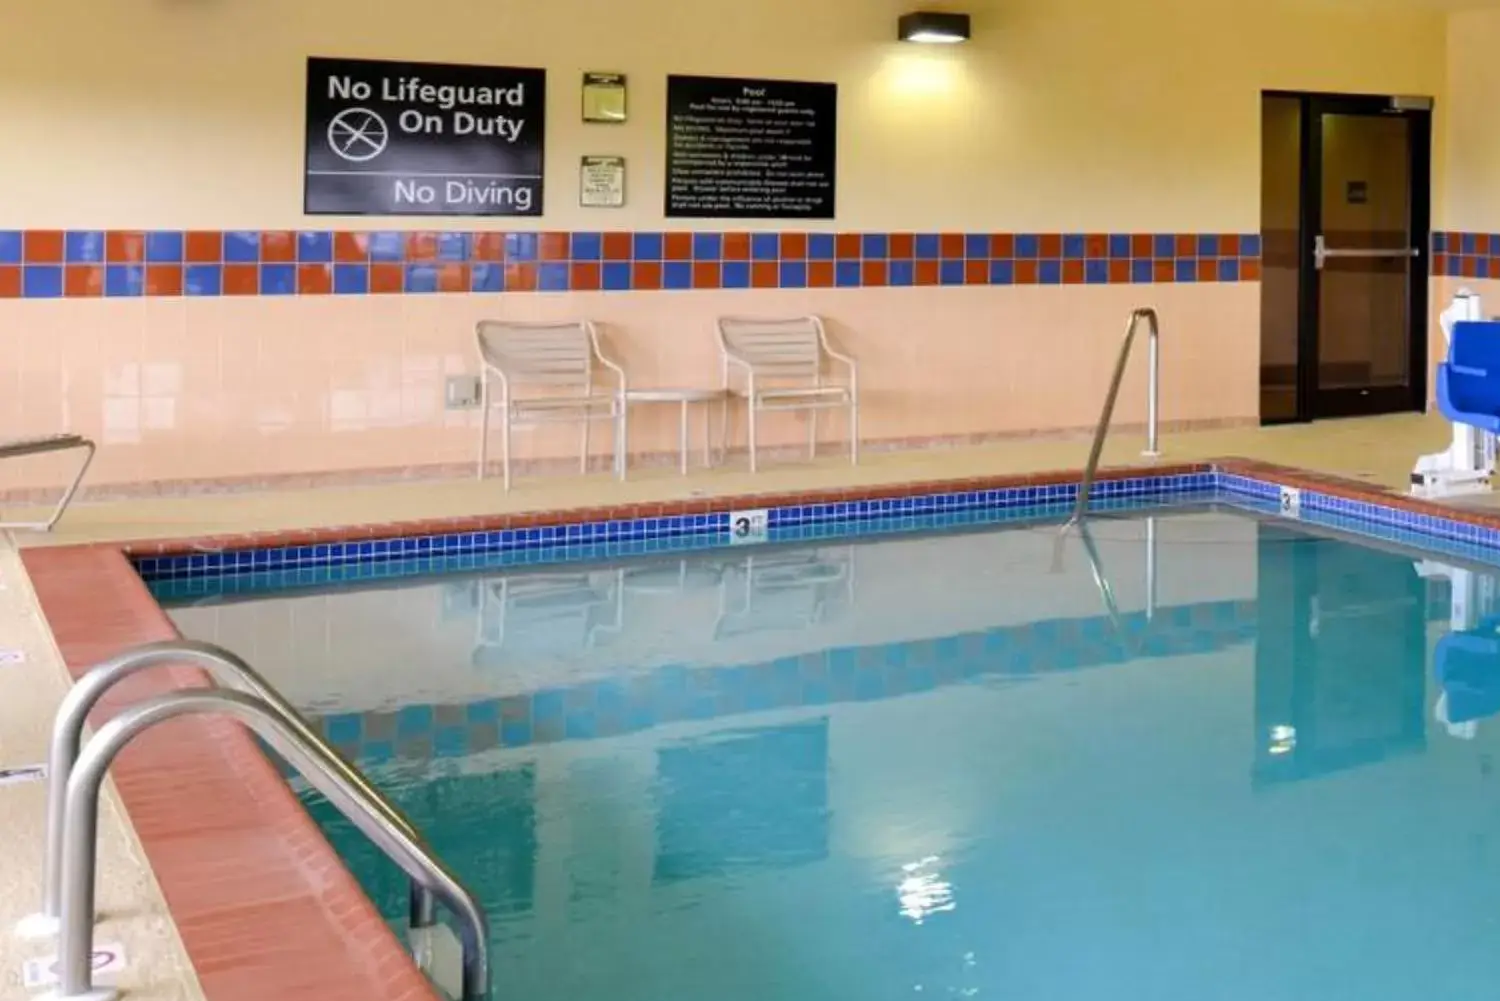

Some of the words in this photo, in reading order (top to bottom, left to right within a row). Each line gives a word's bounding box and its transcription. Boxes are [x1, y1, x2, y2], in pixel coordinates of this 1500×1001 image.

[328, 75, 372, 100] No
[381, 76, 525, 110] Lifeguard
[399, 109, 443, 134] On
[453, 111, 525, 142] Duty
[394, 179, 436, 204] No
[446, 180, 532, 211] Diving
